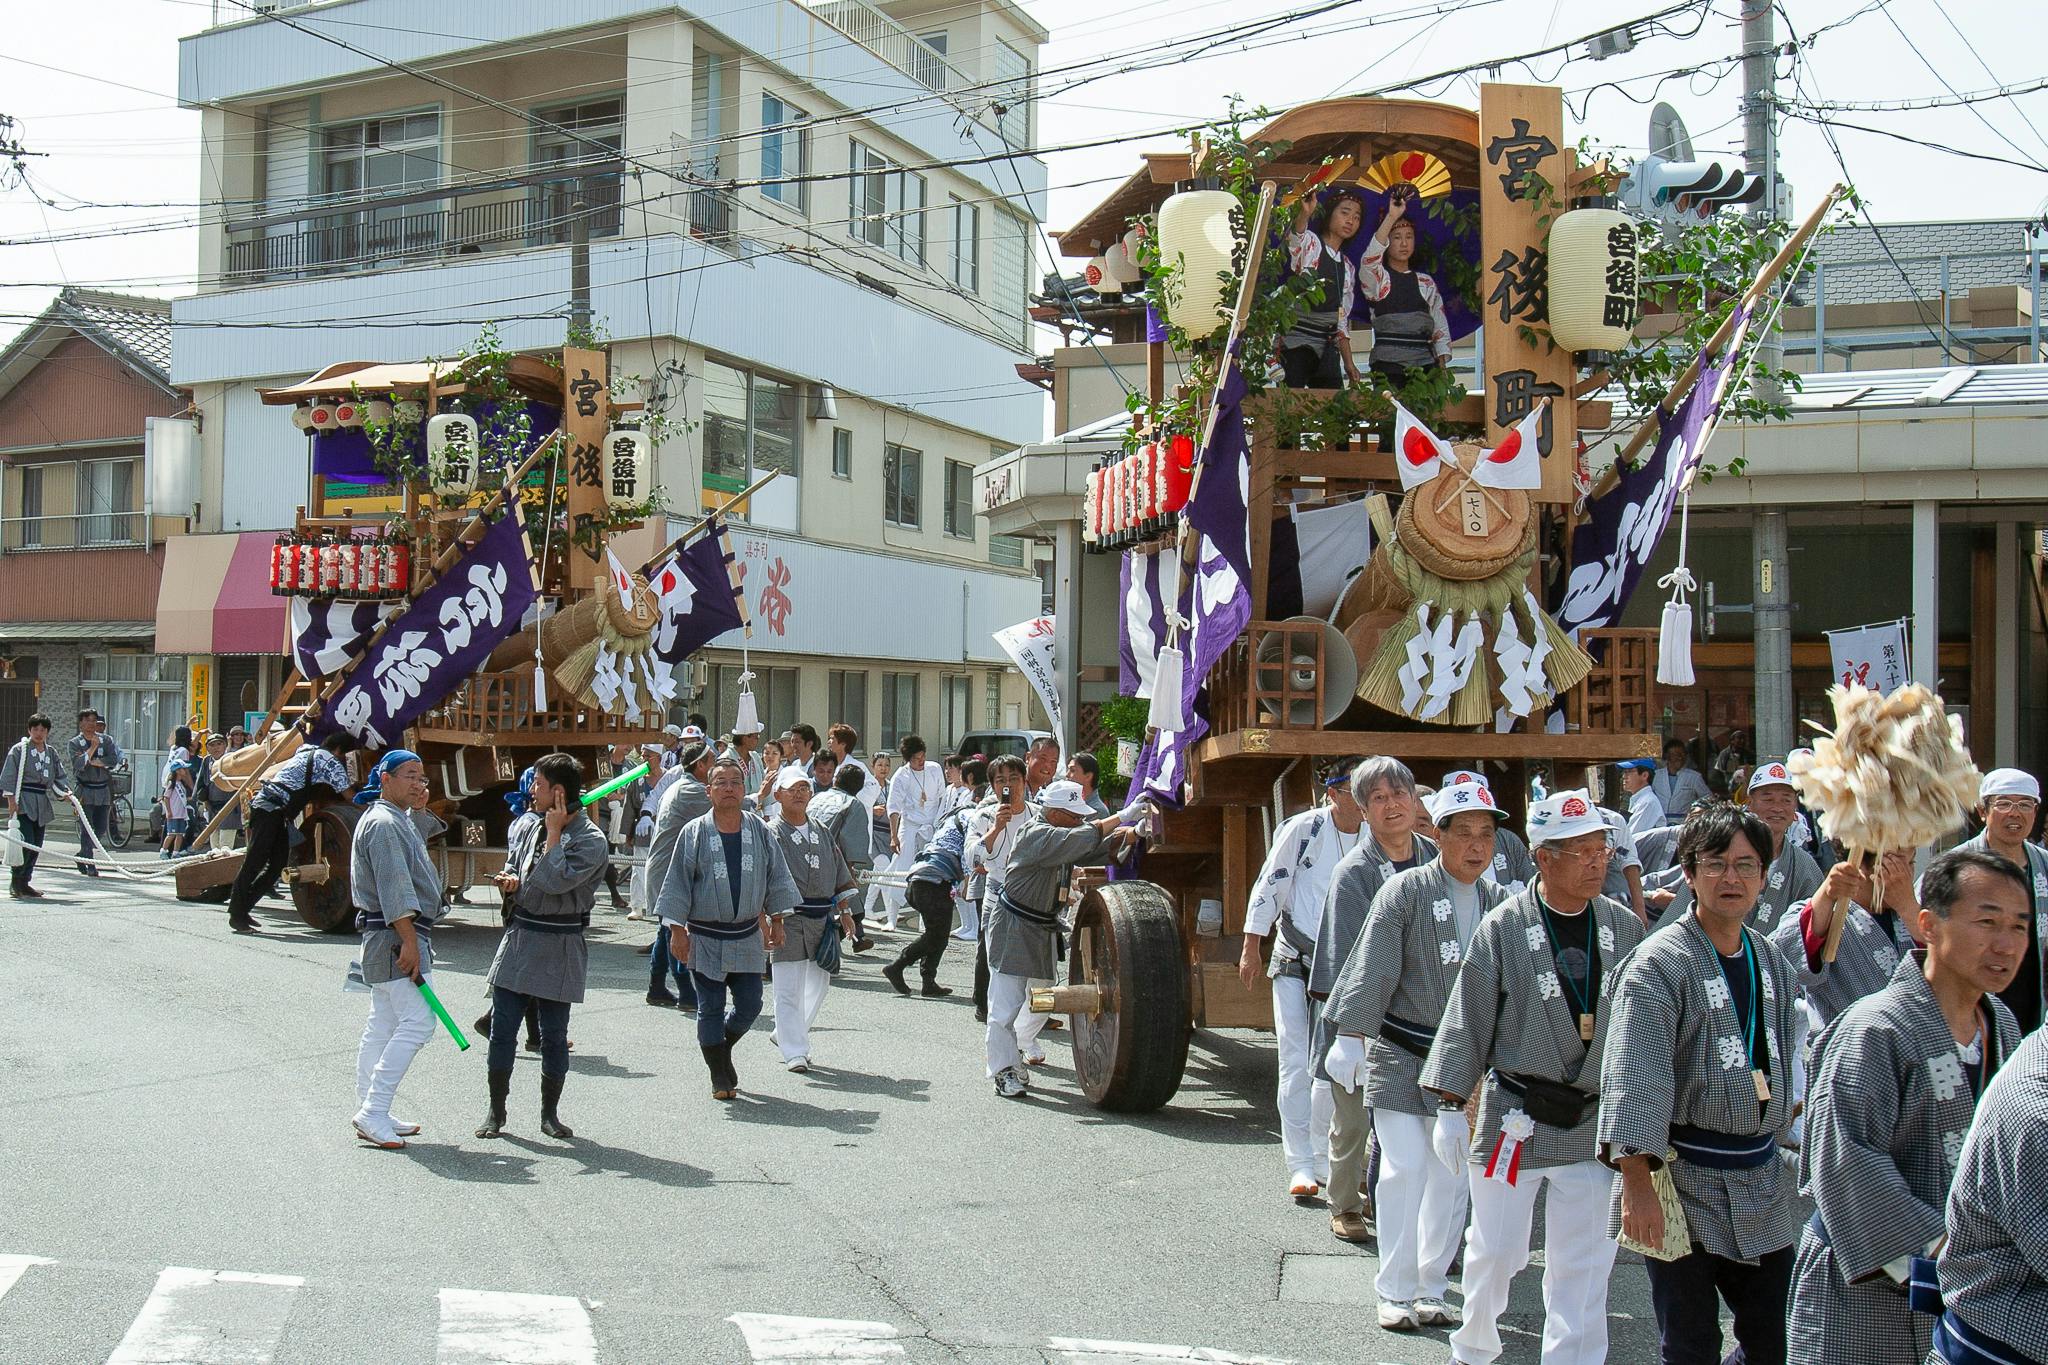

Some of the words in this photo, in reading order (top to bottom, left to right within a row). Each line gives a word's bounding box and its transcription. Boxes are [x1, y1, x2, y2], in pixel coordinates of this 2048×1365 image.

[1487, 118, 1564, 458] 宮後町
[1603, 223, 1639, 331] 宮後町
[570, 368, 604, 564] 宮後町
[612, 436, 636, 499] 宮後町
[745, 540, 767, 560] 菓子司
[1454, 791, 1469, 803] 宮
[1758, 871, 1785, 923] 宮後
[1433, 899, 1461, 965] 伊勢
[1525, 924, 1561, 1000] 伊勢
[1850, 909, 1900, 977] 伊勢
[1704, 976, 1746, 1070] 伊勢
